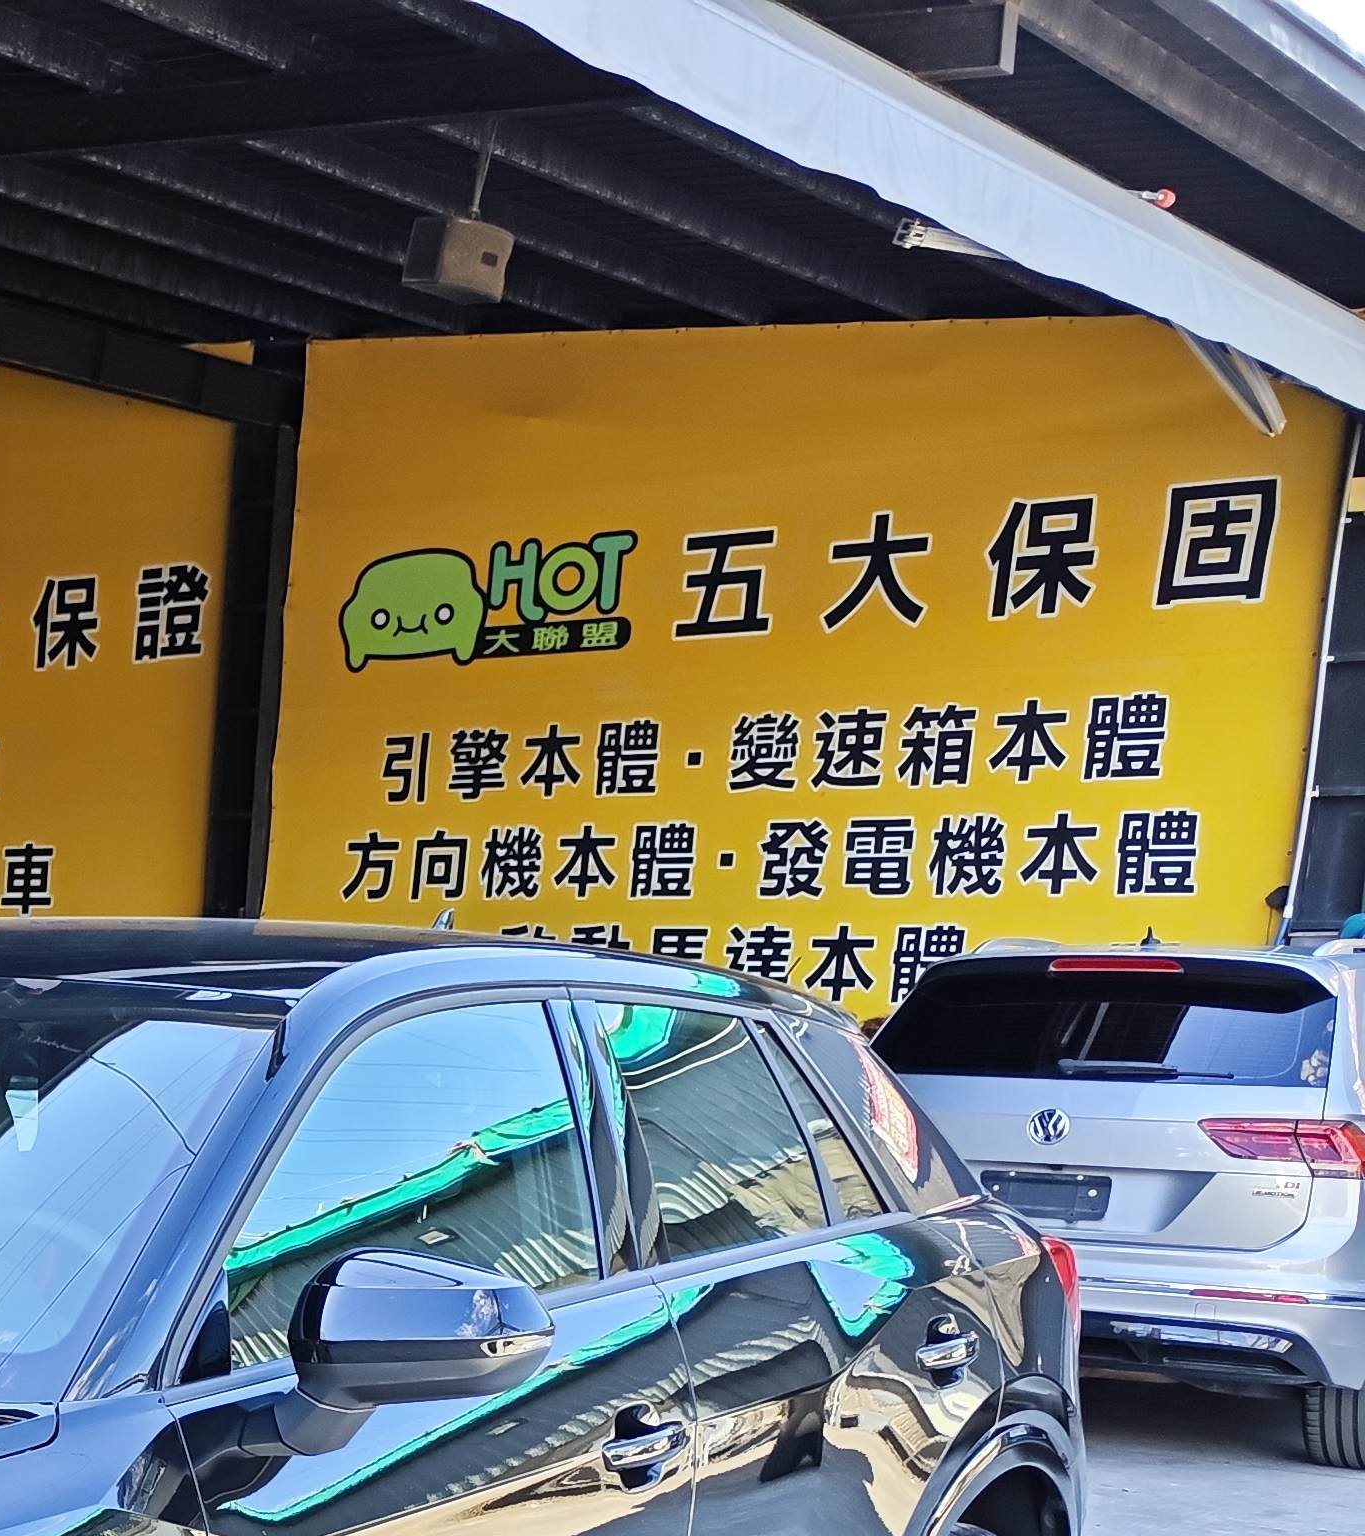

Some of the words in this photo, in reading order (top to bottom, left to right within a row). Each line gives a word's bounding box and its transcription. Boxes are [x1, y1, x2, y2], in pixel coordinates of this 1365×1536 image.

[488, 530, 639, 622] HOT
[671, 475, 1282, 641] 五大保固
[482, 622, 619, 655] 大聯盟
